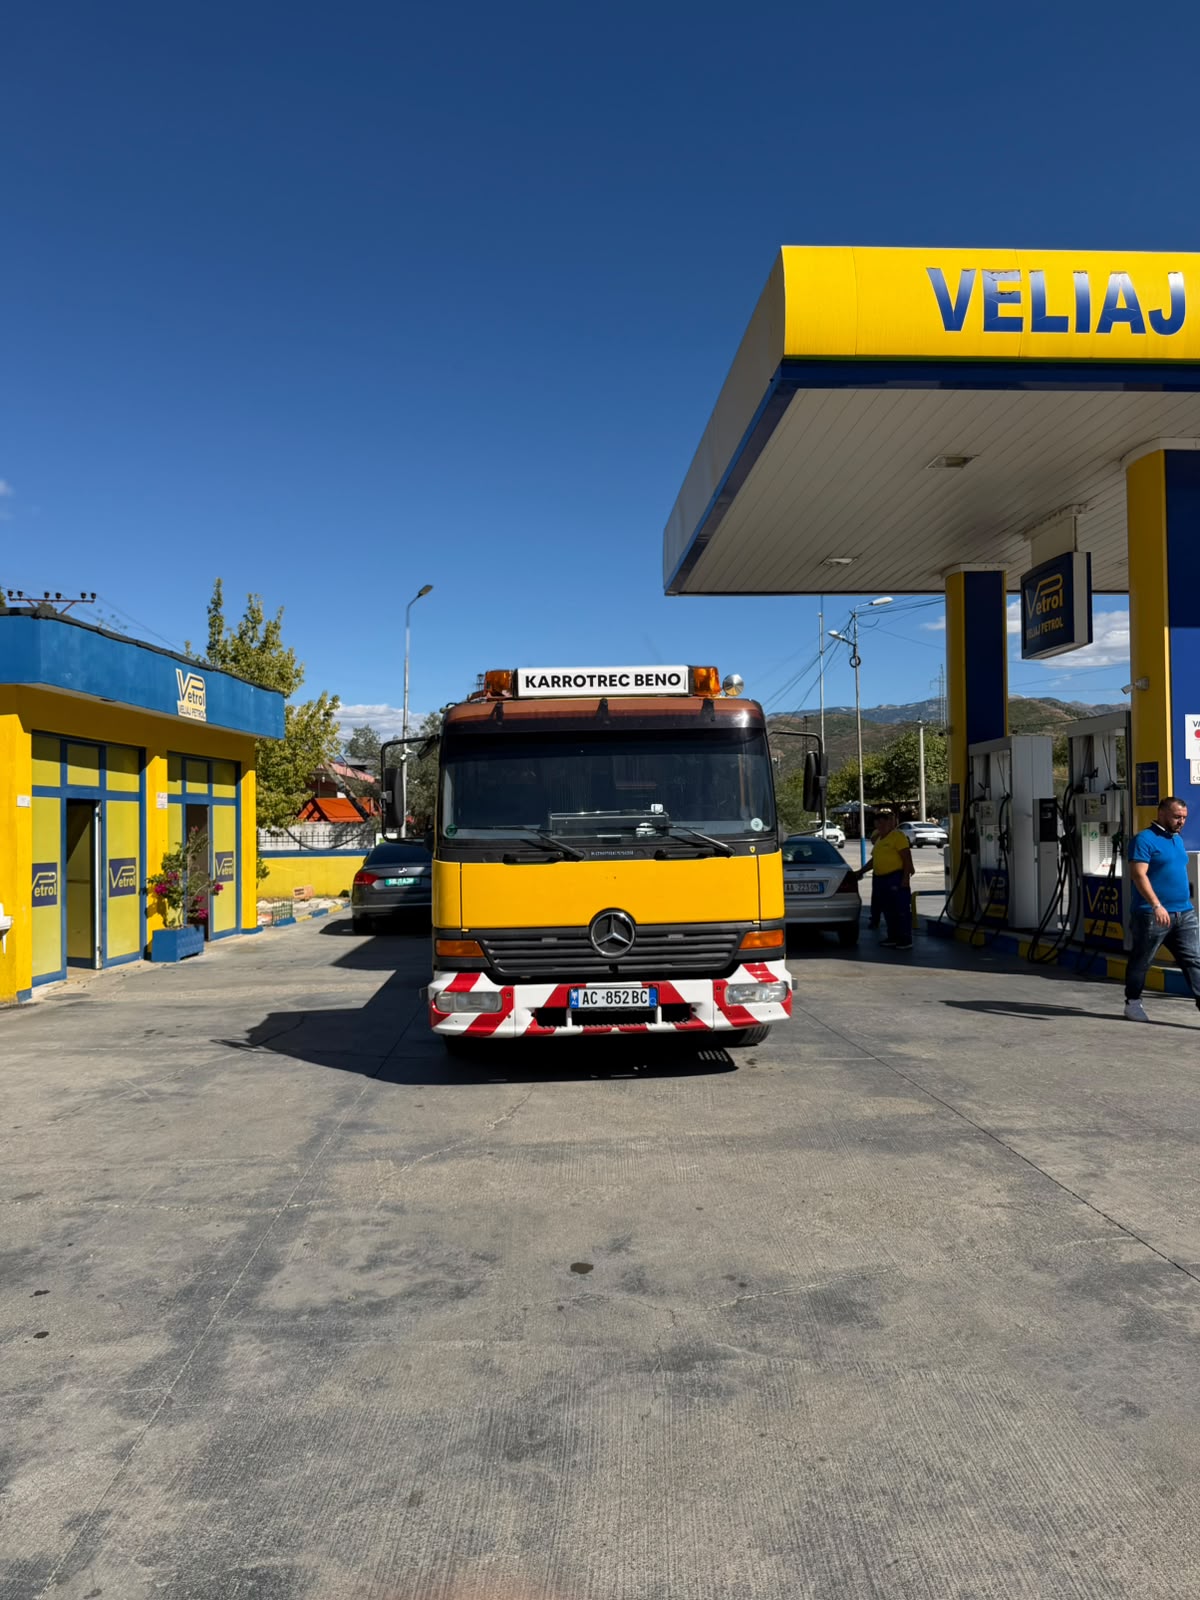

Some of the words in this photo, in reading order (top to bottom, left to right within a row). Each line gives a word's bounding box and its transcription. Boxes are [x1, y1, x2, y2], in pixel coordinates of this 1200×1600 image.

[926, 267, 1186, 336] VELIAJ
[525, 673, 630, 688] KARROTREC
[634, 672, 681, 687] BENO
[582, 991, 598, 1005] AC
